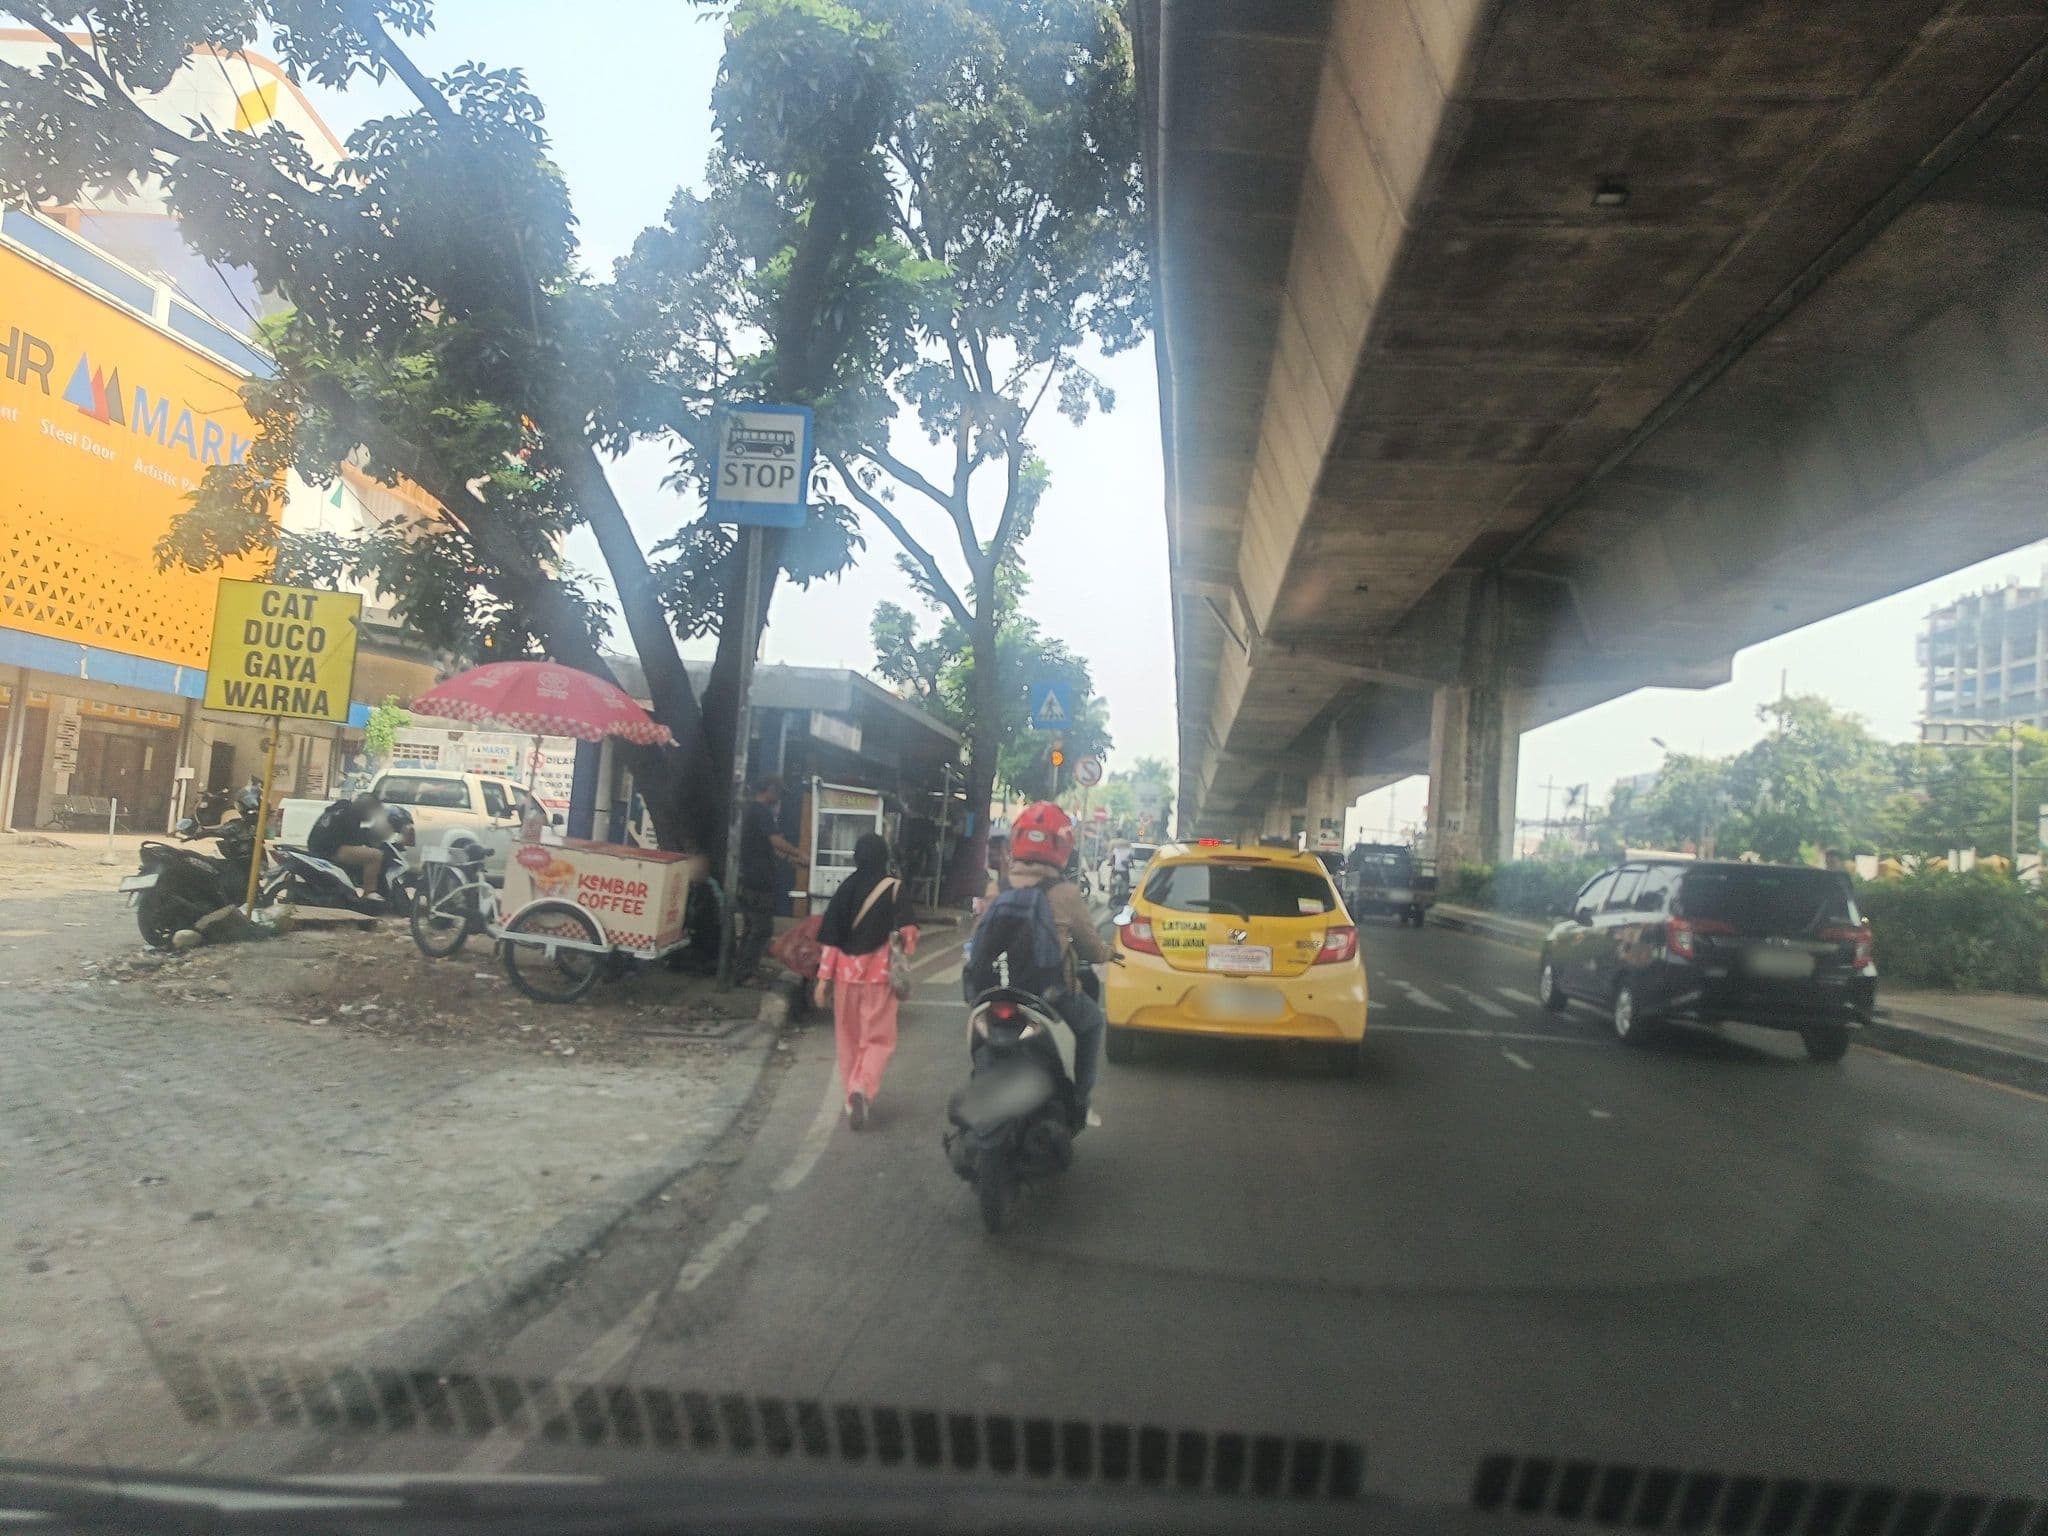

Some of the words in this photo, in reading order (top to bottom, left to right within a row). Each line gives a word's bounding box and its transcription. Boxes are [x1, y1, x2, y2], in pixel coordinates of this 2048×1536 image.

[131, 385, 268, 487] MARK
[39, 418, 78, 446] Steel
[81, 434, 116, 461] Door
[134, 457, 178, 489] Artistic
[723, 462, 795, 489] STOP
[261, 590, 319, 621] CAT
[243, 618, 326, 653] DUCO
[244, 650, 317, 684] GAYA
[224, 679, 330, 716] WARNA
[577, 892, 646, 916] COFFEE
